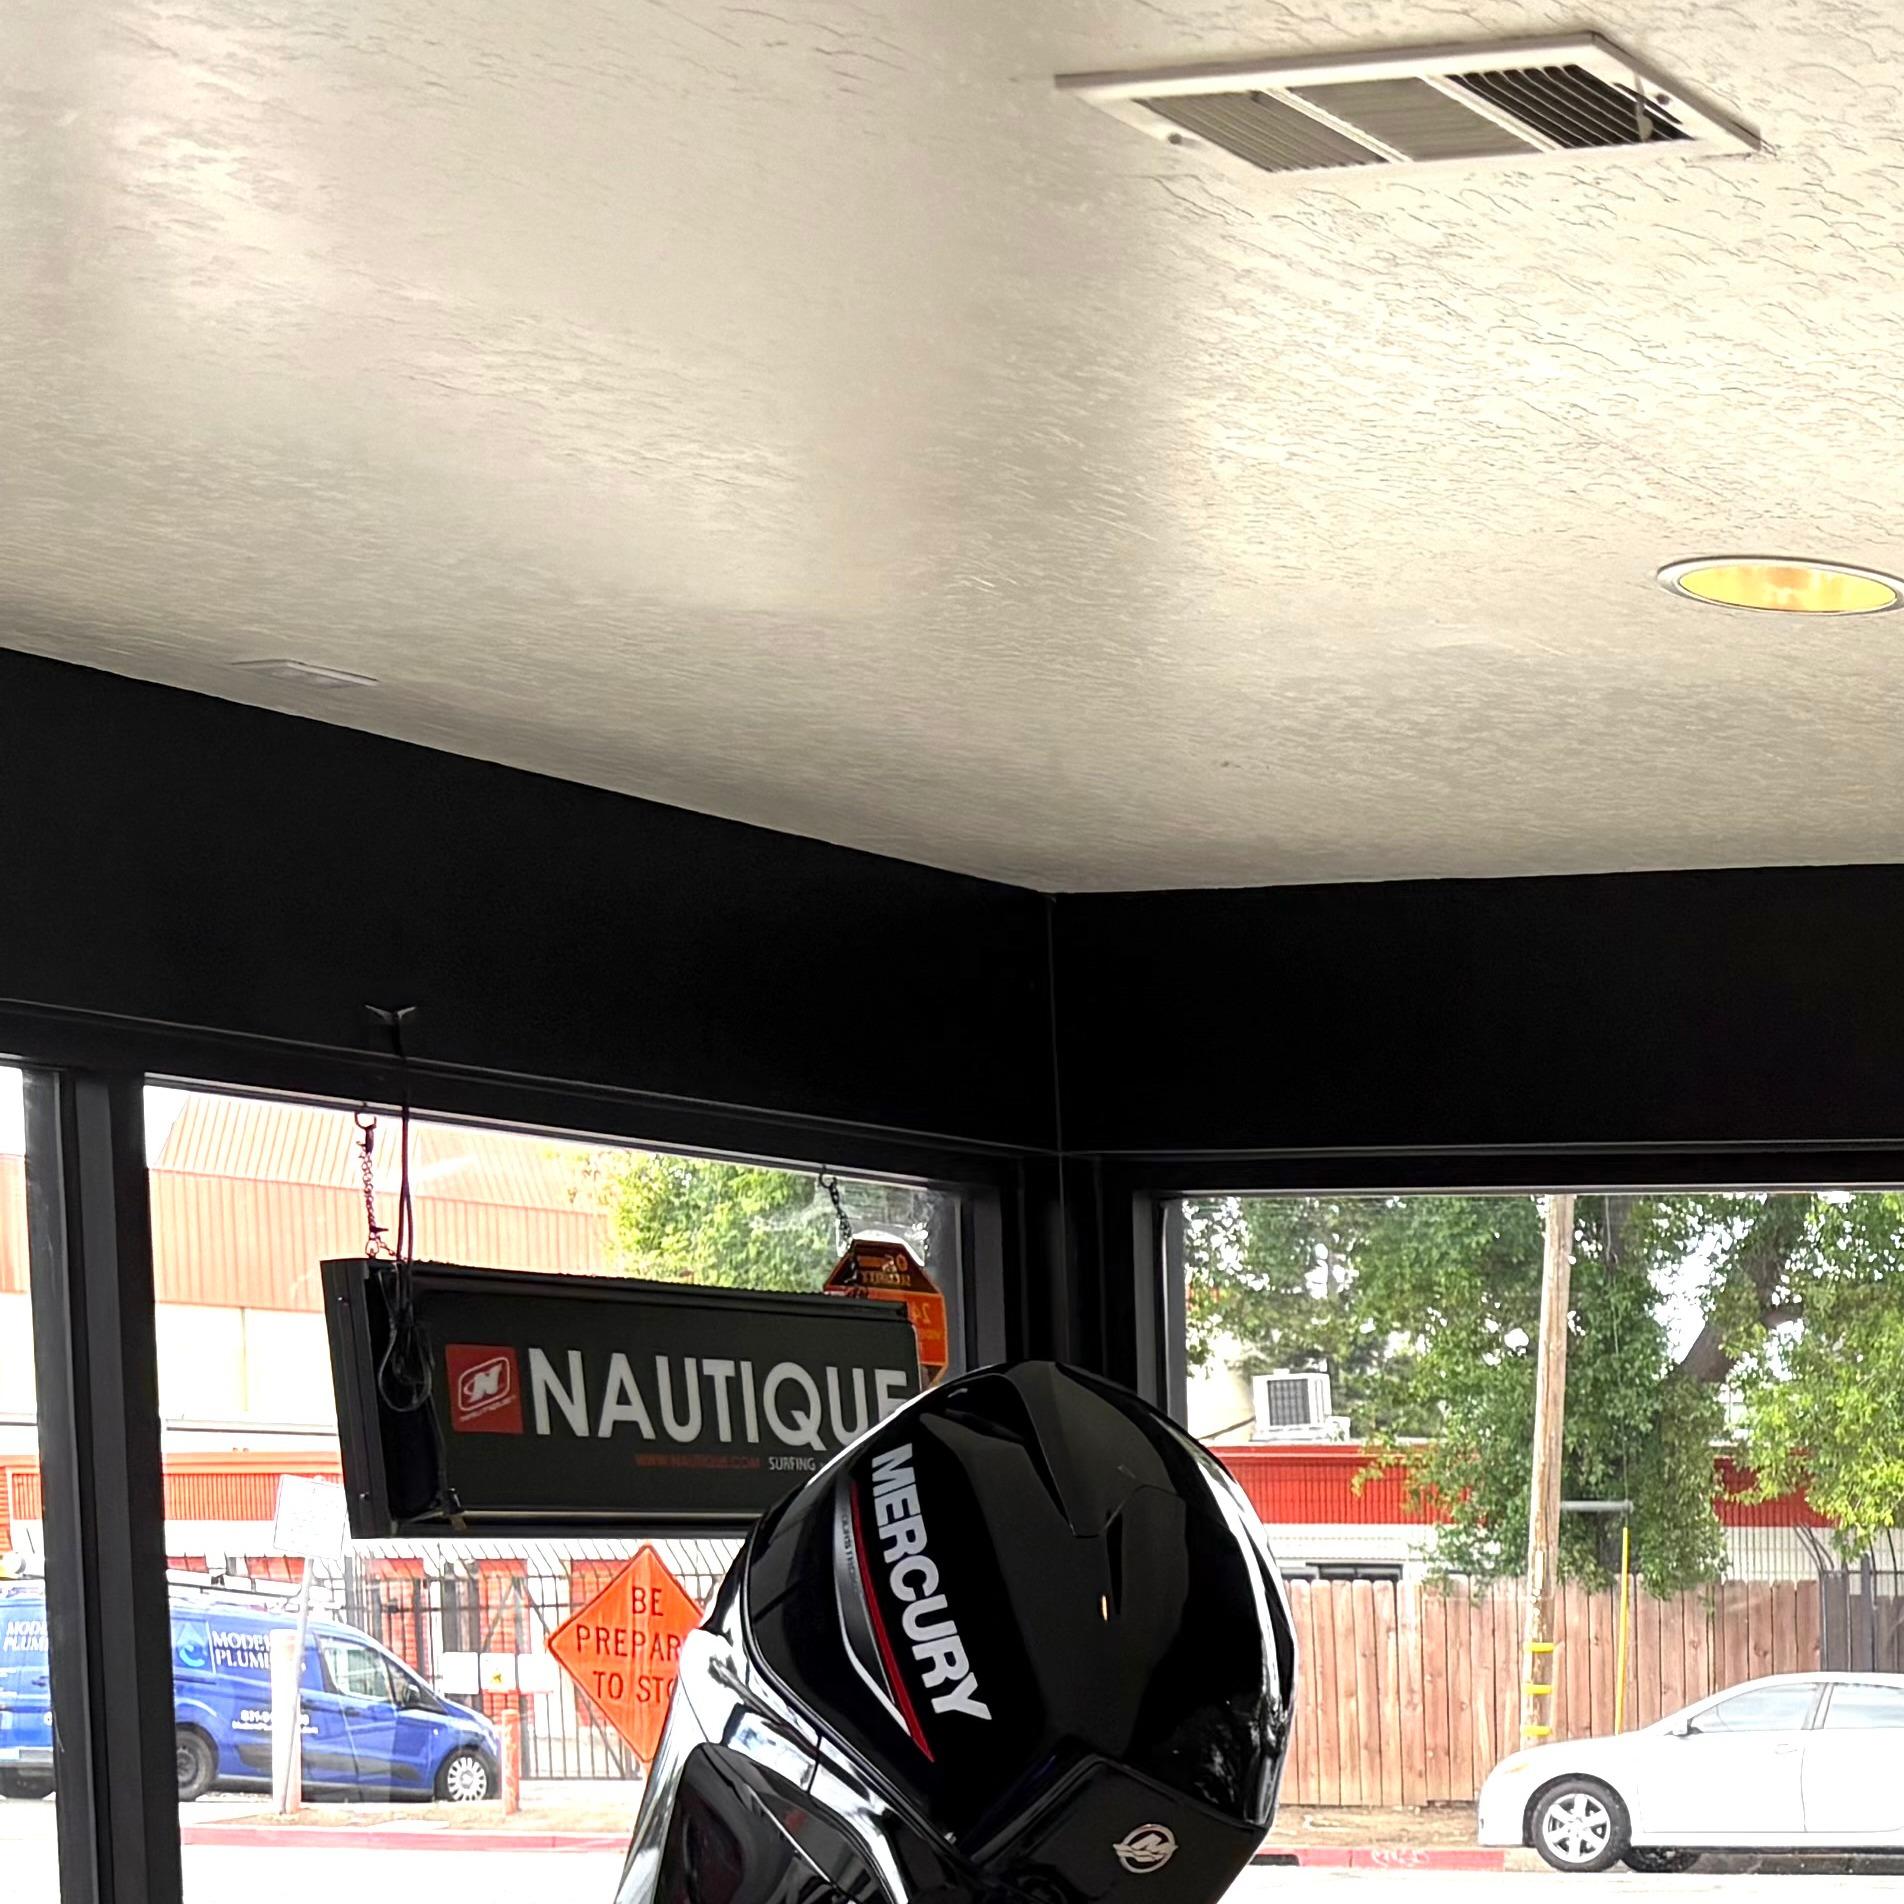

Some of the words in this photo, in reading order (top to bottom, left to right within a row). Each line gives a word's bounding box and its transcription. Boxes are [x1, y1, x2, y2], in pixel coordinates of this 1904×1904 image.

[528, 1347, 908, 1452] NAUTIQUE
[768, 1455, 816, 1471] SURFING
[871, 1442, 993, 1721] MERCURY
[632, 1586, 664, 1617] BE
[6, 1620, 47, 1636] MOD
[212, 1630, 271, 1650] MODE
[576, 1624, 681, 1661] PREPAR
[593, 1670, 624, 1700] TO
[636, 1675, 674, 1704] ST
